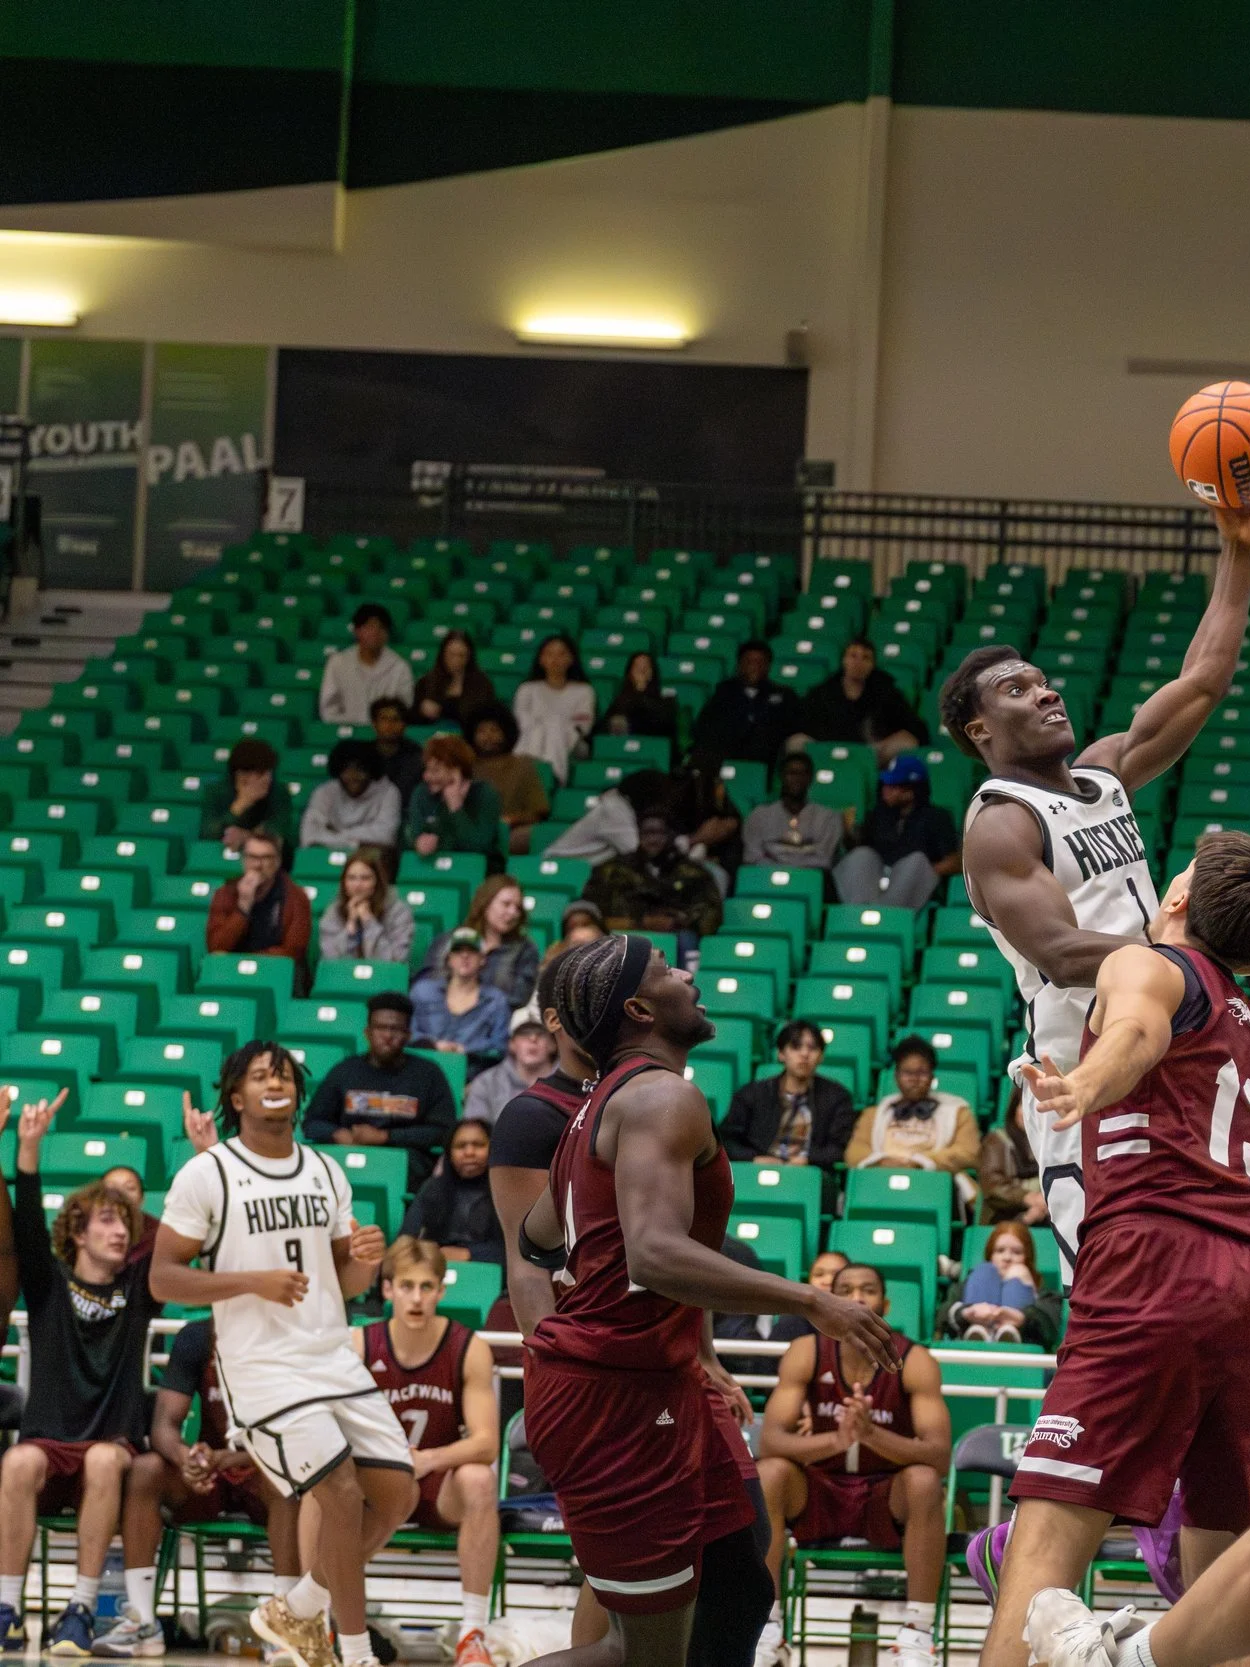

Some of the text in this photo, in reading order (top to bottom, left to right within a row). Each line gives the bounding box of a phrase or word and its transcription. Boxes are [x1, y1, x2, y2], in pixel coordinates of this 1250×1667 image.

[278, 487, 298, 521] 7
[244, 1194, 330, 1235] HUSKIES
[285, 1238, 304, 1273] 9
[400, 1408, 429, 1448] 7
